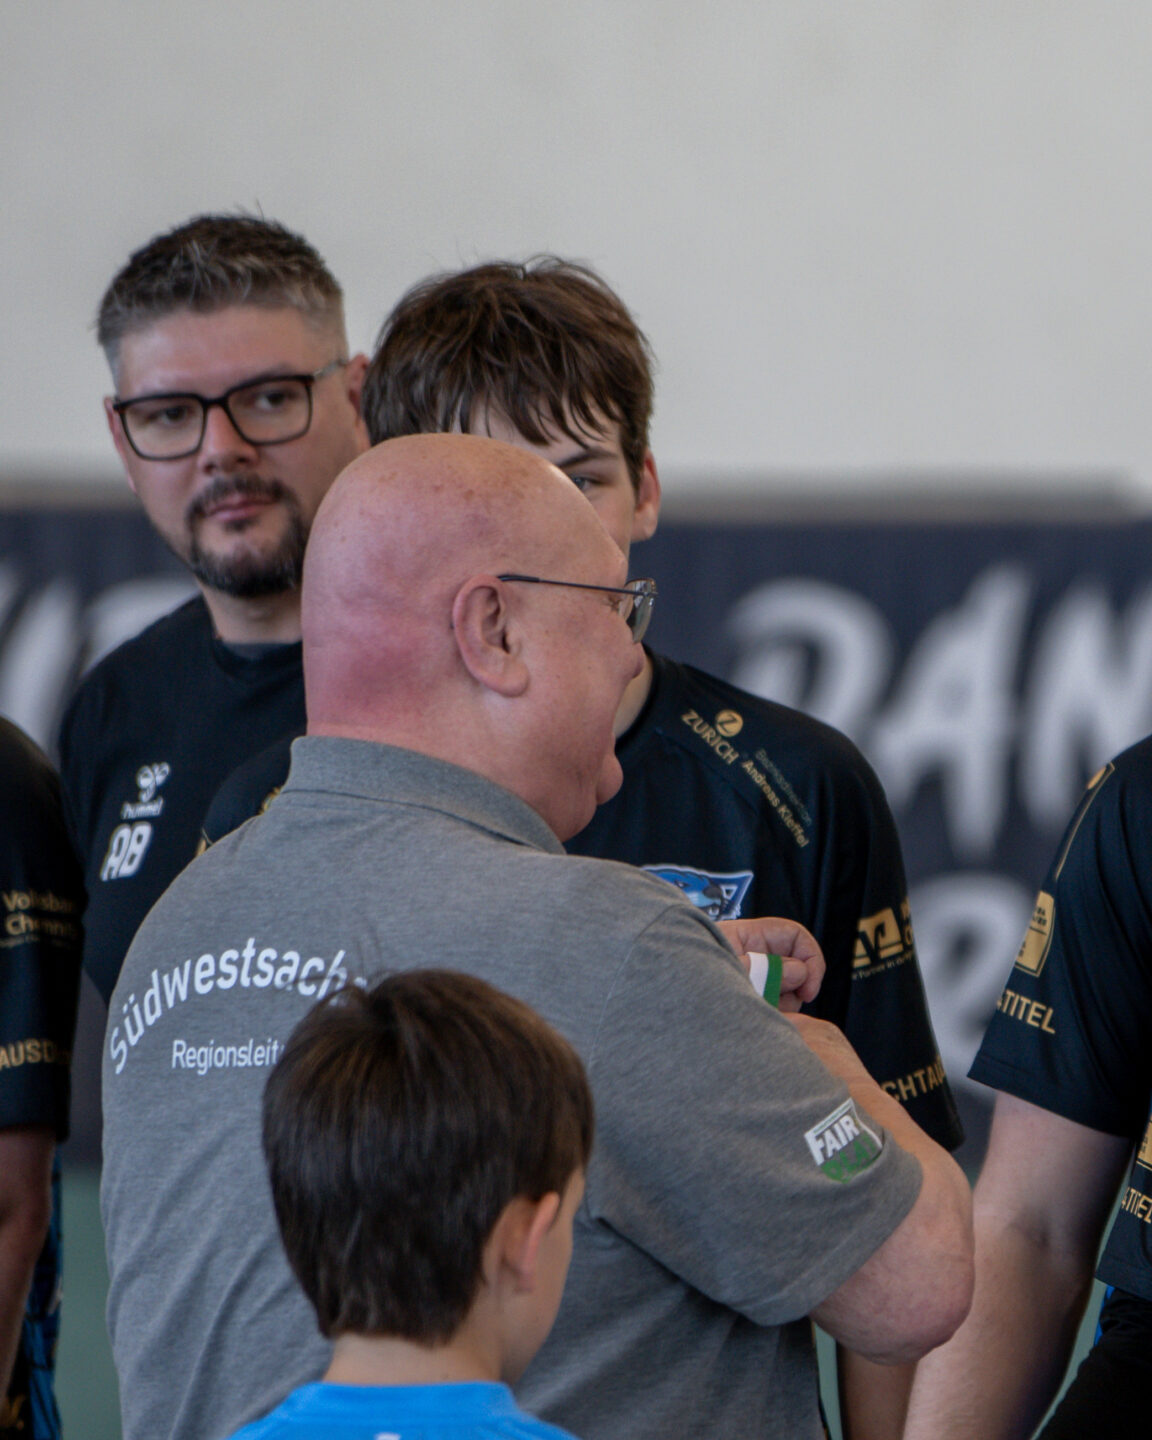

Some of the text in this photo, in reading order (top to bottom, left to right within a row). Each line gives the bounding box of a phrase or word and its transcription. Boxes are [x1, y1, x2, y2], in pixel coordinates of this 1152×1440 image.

[681, 708, 740, 765] ZURICH
[121, 799, 163, 820] hummel
[101, 821, 153, 882] AB
[108, 936, 367, 1076] Südwestsach
[171, 1038, 285, 1076] Regionsleit
[803, 1112, 861, 1167] FAIR
